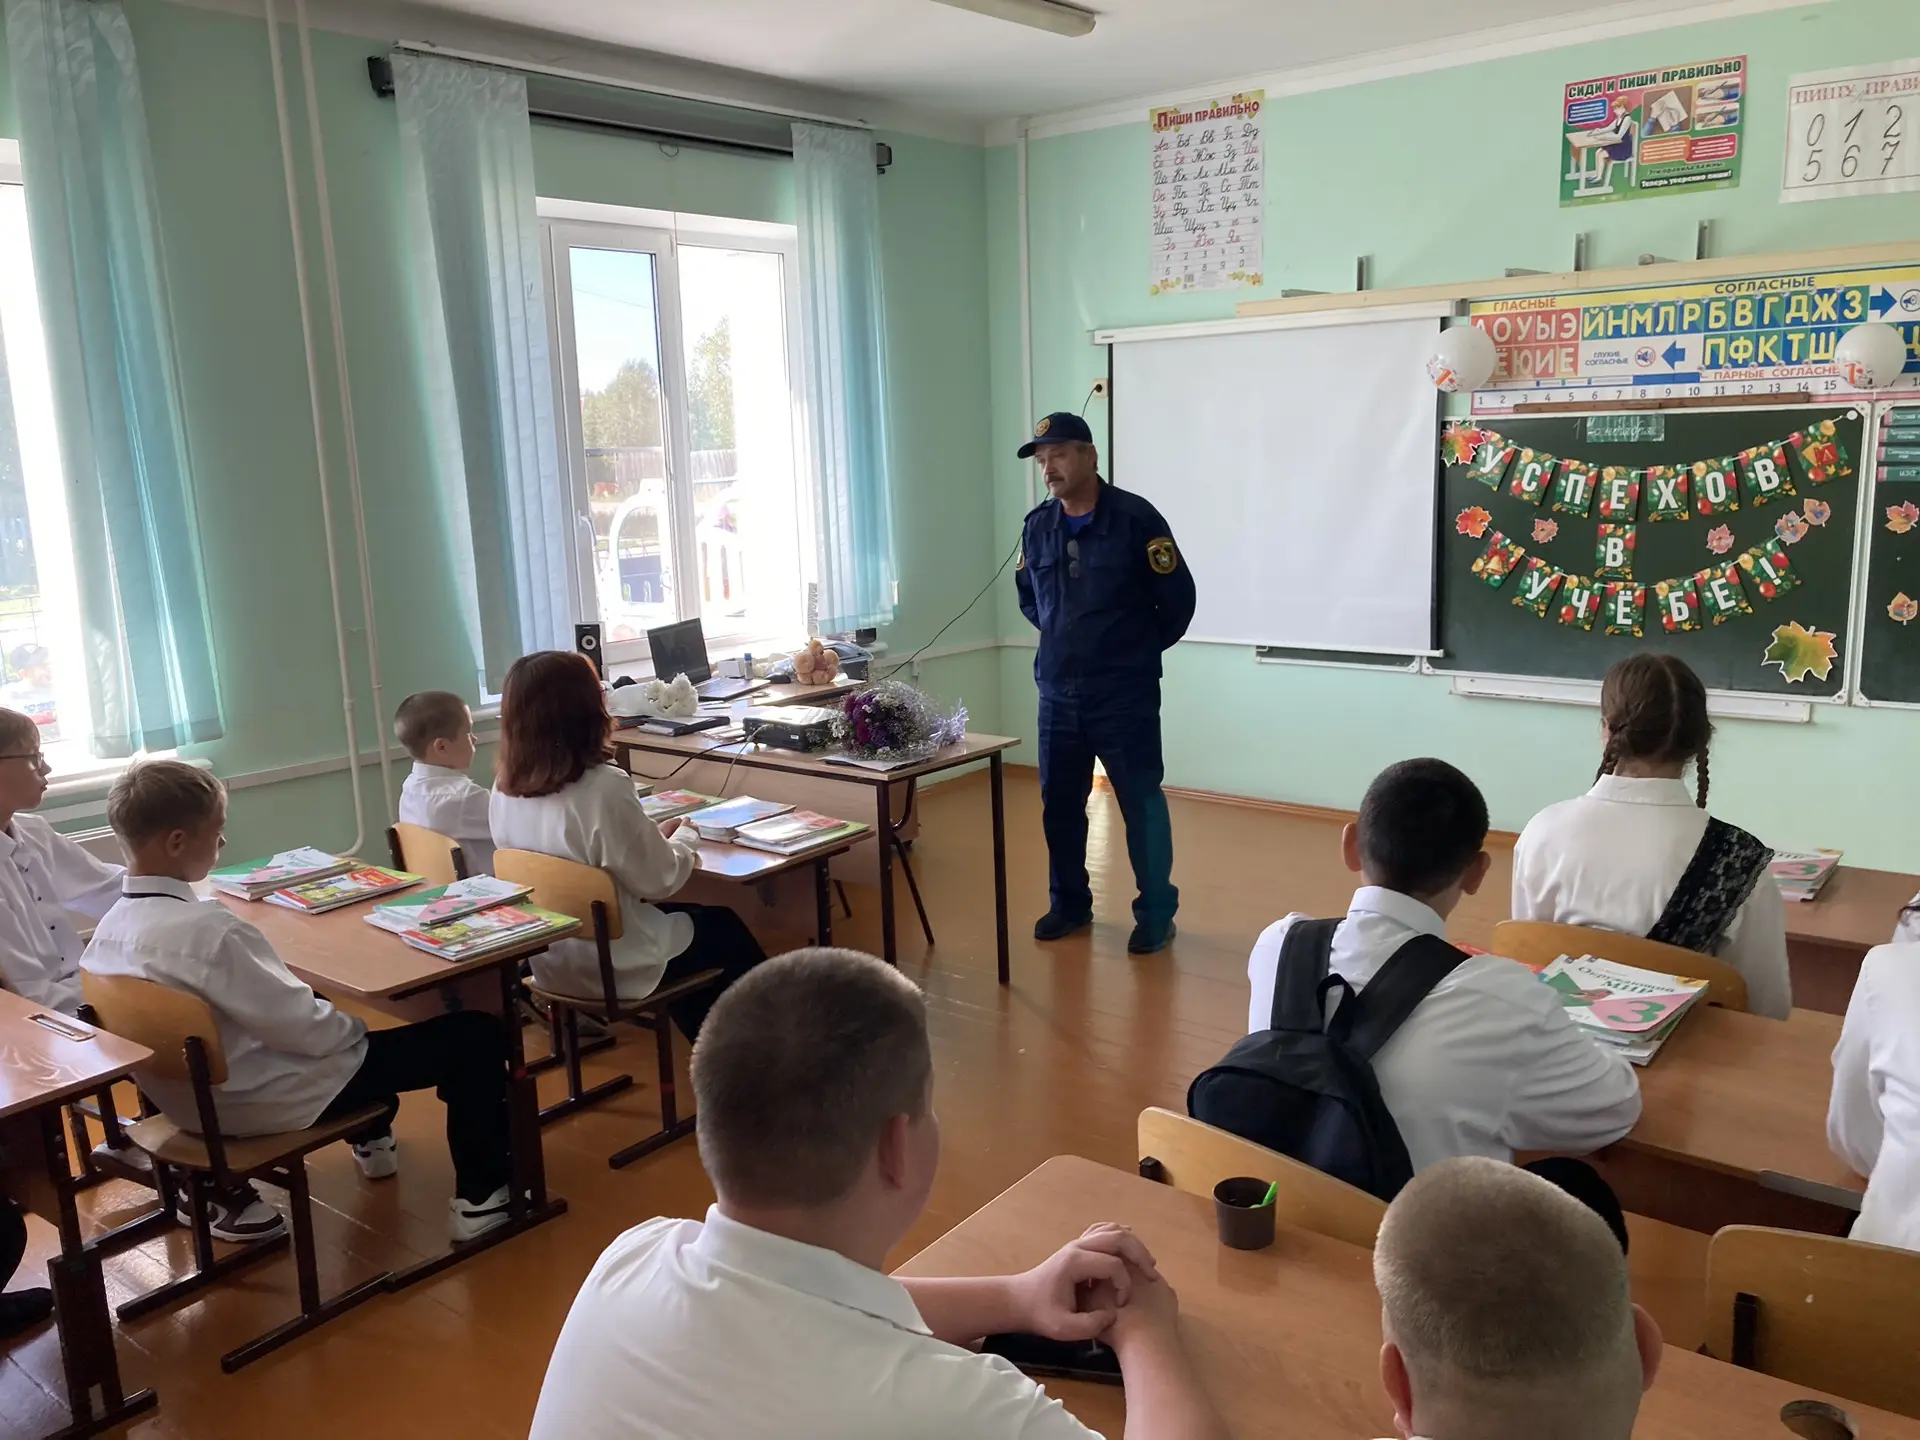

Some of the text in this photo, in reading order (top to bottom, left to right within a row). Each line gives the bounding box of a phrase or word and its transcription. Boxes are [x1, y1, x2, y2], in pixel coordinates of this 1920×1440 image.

[1569, 60, 1741, 98] СИДИ И ПИШИ ПРАВИЛЬНО
[1796, 84, 1856, 103] ПИШУ
[1195, 101, 1260, 122] ПРАВИЛЬНО
[1807, 104, 1902, 146] 0 1 2
[1802, 140, 1900, 182] 5 6 7
[1715, 277, 1816, 294] СОГЛАСНЫЕ
[1494, 298, 1556, 312] ГЛАСНЫЕ
[1714, 369, 1764, 380] ПАРНЫЕ
[1500, 395, 1506, 404] 2
[1522, 394, 1529, 403] 3
[1544, 393, 1551, 402] 4
[1569, 392, 1575, 401] 5
[1592, 391, 1598, 400] 6
[1616, 390, 1622, 399] 7
[1640, 389, 1646, 398] 8
[1665, 388, 1671, 397] 9
[1688, 387, 1700, 396] 10
[1715, 386, 1725, 395] 11
[1741, 384, 1753, 394] 12
[1769, 383, 1781, 393] 13
[1797, 382, 1809, 392] 14
[1824, 380, 1836, 390] 15
[1605, 537, 1624, 567] В
[1607, 1000, 1667, 1024] 3
